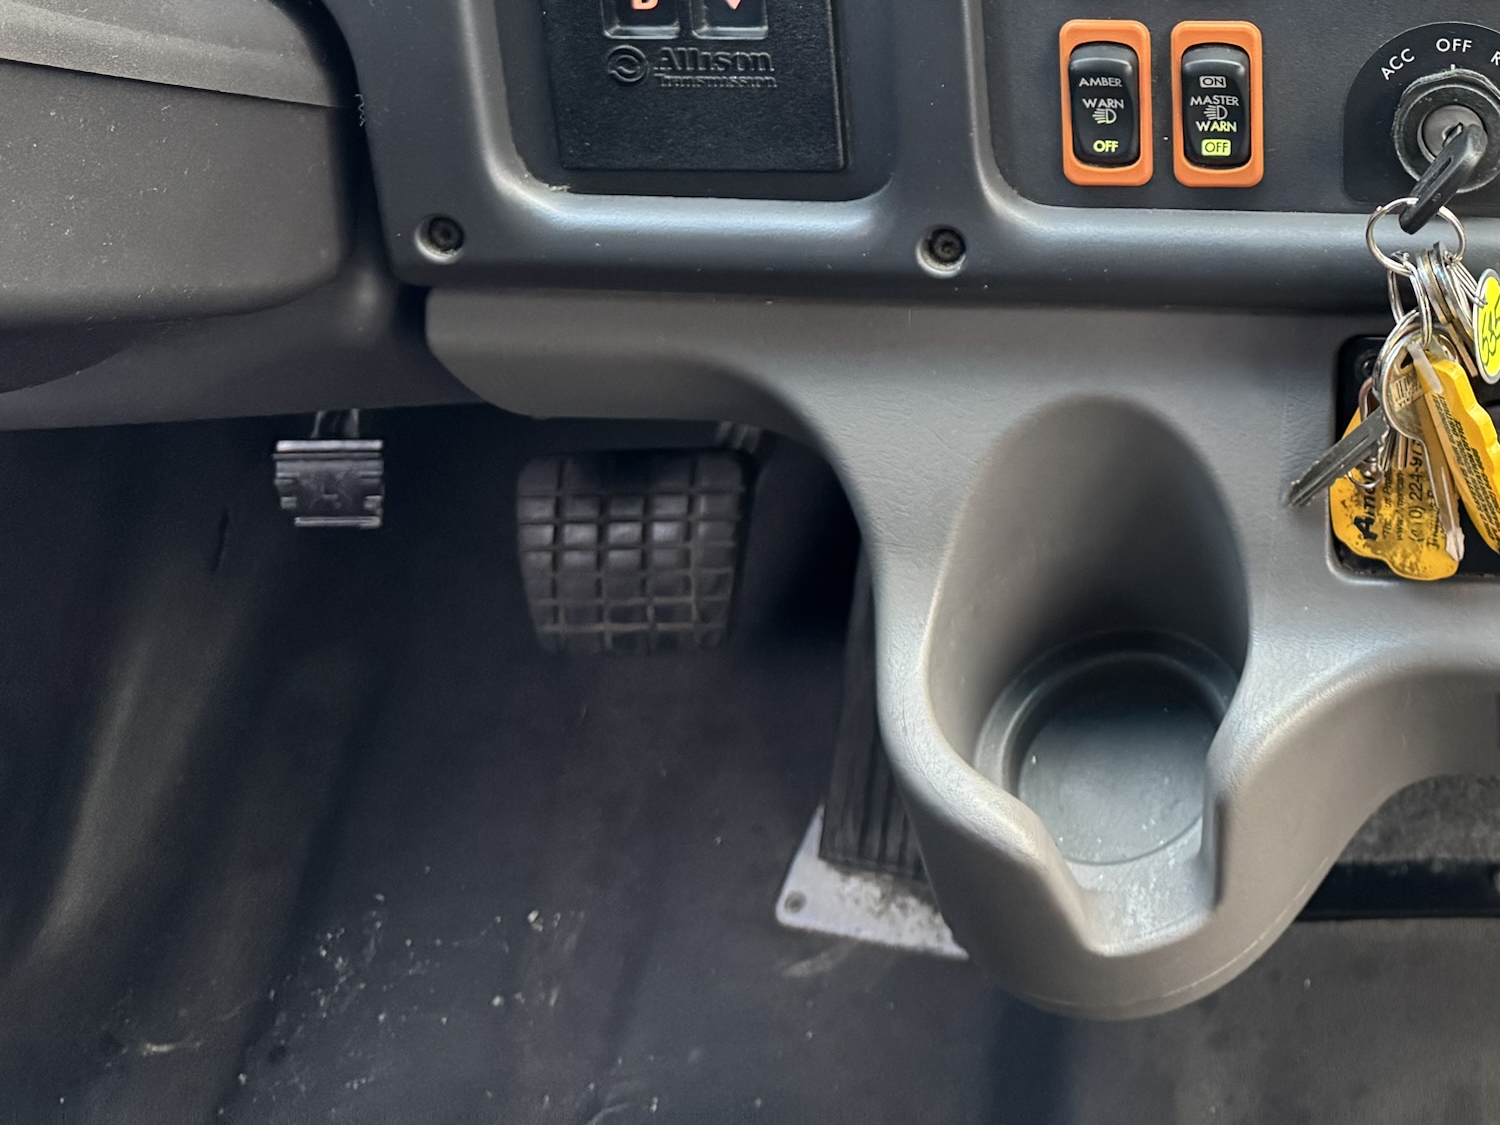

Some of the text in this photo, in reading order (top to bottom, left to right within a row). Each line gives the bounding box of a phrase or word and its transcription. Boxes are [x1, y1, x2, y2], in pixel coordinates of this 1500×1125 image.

[653, 46, 775, 72] Allison
[1380, 48, 1415, 81] ACC
[1436, 38, 1473, 52] OFF
[1079, 77, 1122, 87] AMBER
[1202, 78, 1224, 86] ON
[1082, 98, 1125, 109] WARN
[1190, 95, 1240, 106] MASTER
[1195, 121, 1237, 133] WARN
[1093, 140, 1119, 152] OFF
[1204, 142, 1228, 153] OFF
